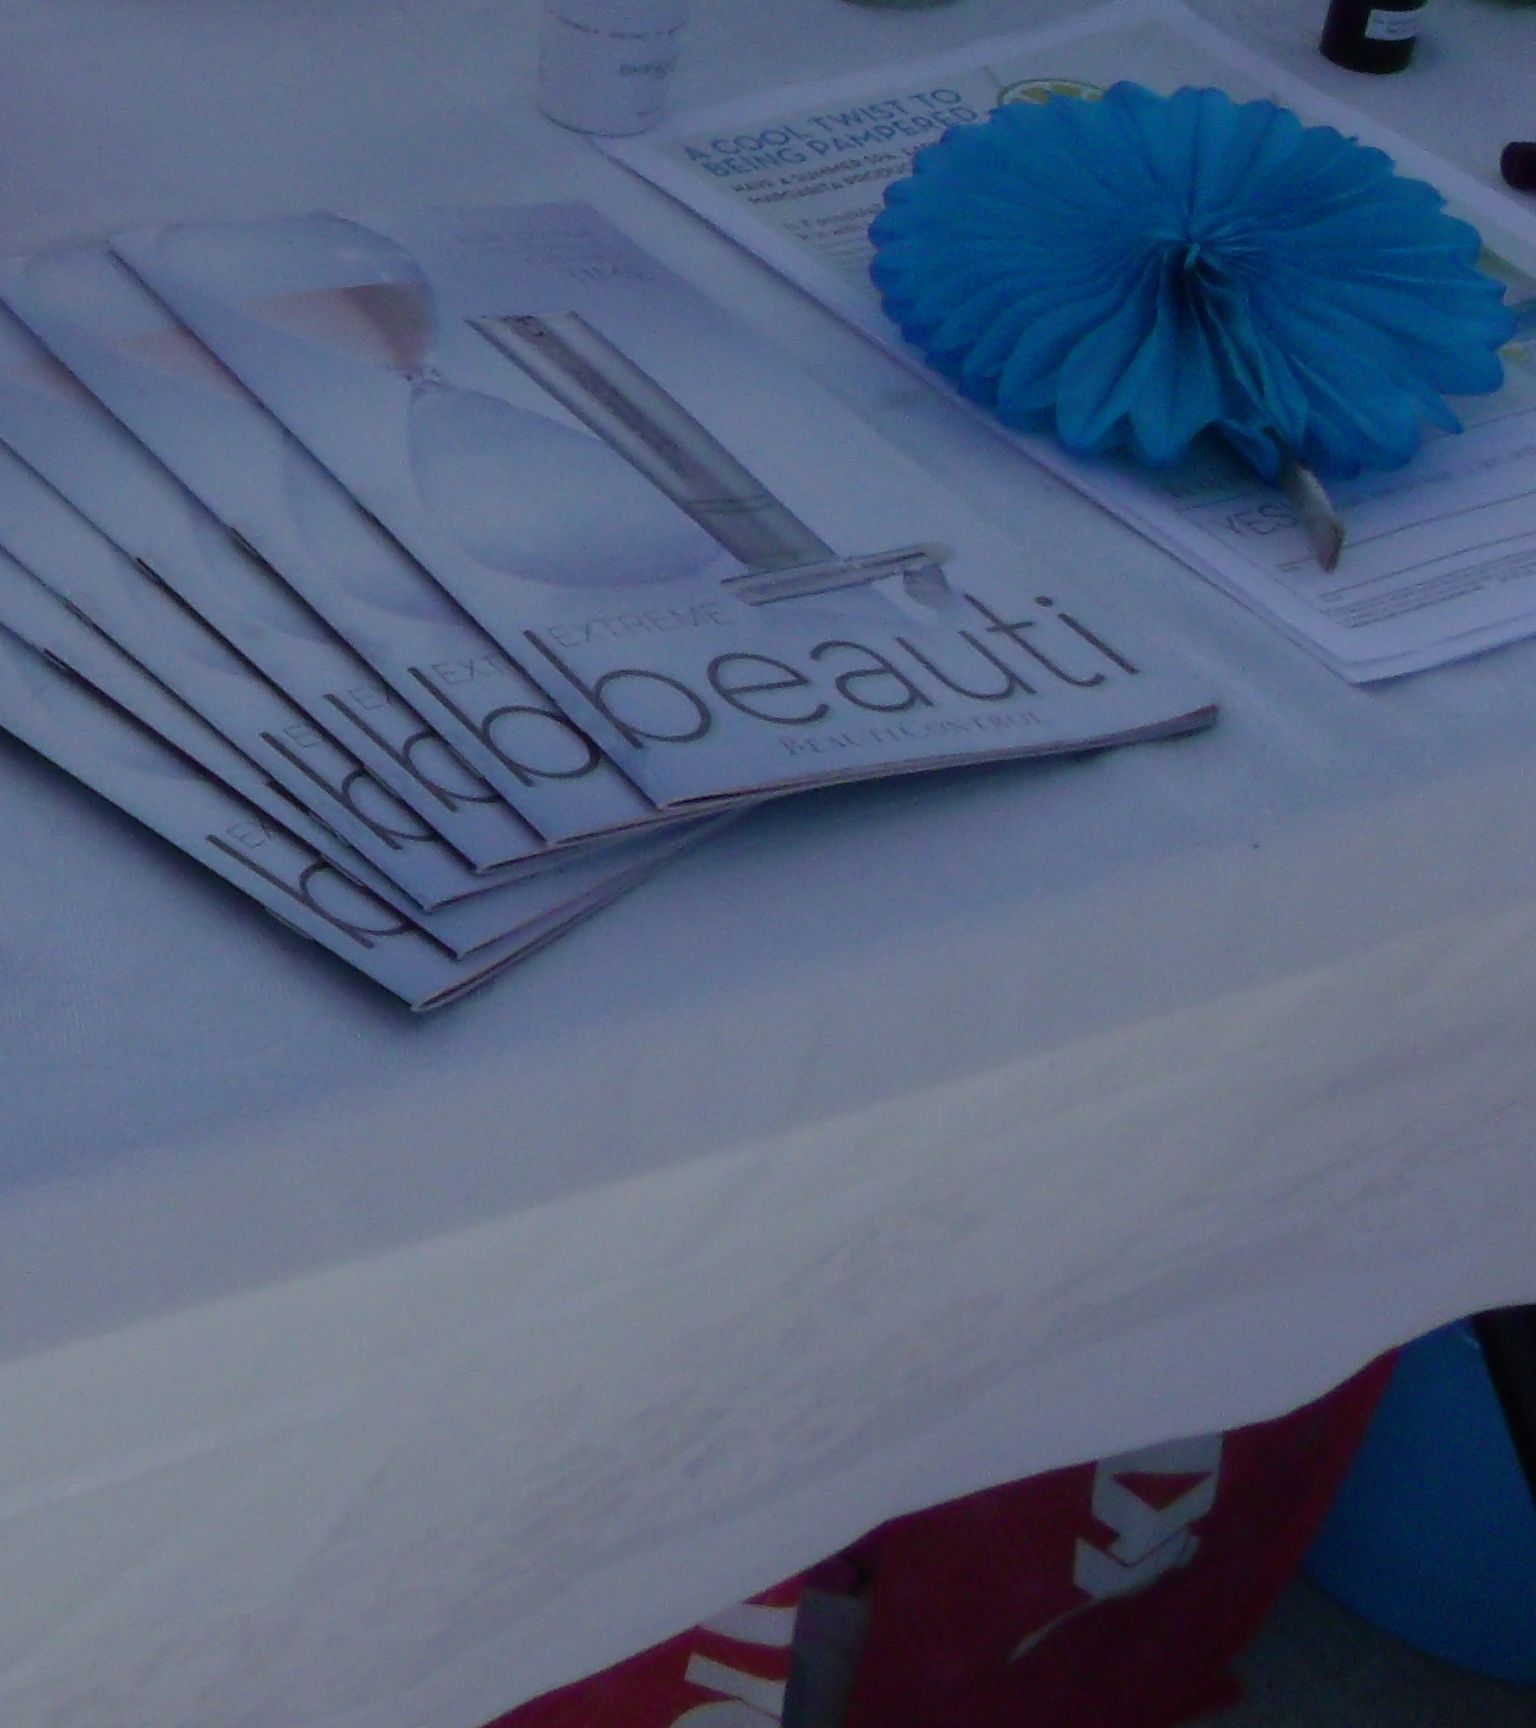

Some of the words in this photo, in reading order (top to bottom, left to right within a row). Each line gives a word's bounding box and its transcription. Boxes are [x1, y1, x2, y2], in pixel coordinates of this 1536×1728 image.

[682, 144, 711, 163] A
[710, 125, 808, 156] COOL
[809, 99, 909, 132] TWIST
[909, 88, 963, 110] TO
[700, 148, 807, 179] BEING
[806, 106, 978, 157] PAMPERED
[546, 601, 732, 650] EXTREME
[522, 592, 1142, 750] beauti
